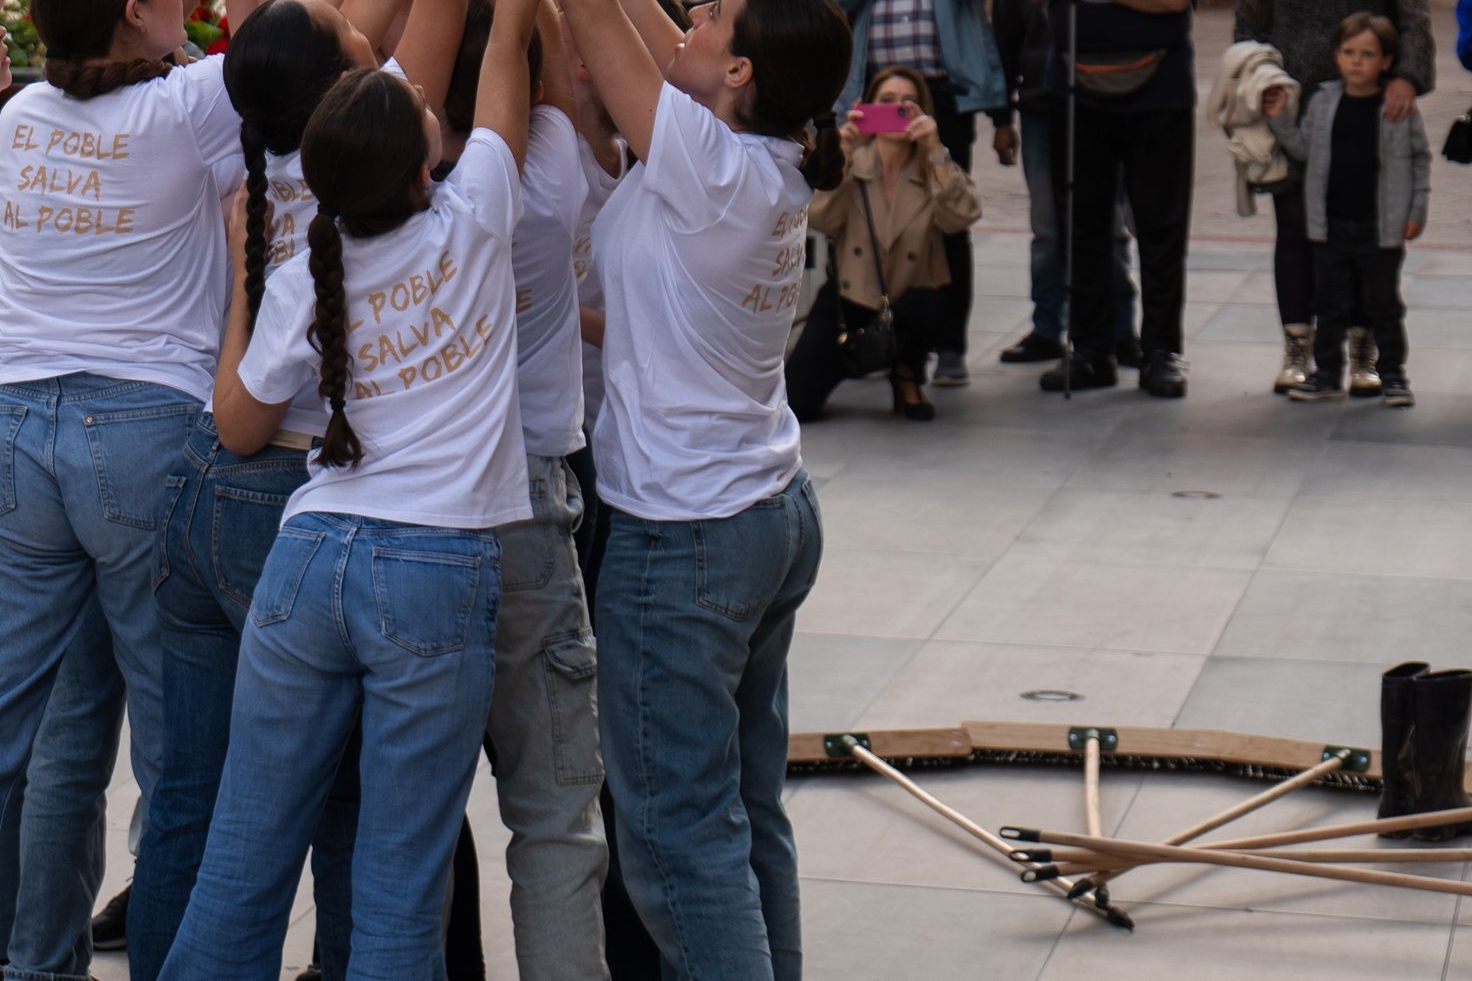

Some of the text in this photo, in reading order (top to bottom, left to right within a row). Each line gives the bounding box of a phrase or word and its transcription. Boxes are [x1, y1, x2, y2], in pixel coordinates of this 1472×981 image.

[12, 124, 130, 160] EL POBLE
[18, 165, 101, 202] SALVA
[4, 200, 135, 235] AL POBLE
[368, 250, 458, 324] POBLE
[740, 283, 772, 315] AL
[358, 307, 457, 372] SALVA
[398, 314, 493, 390] POBLE
